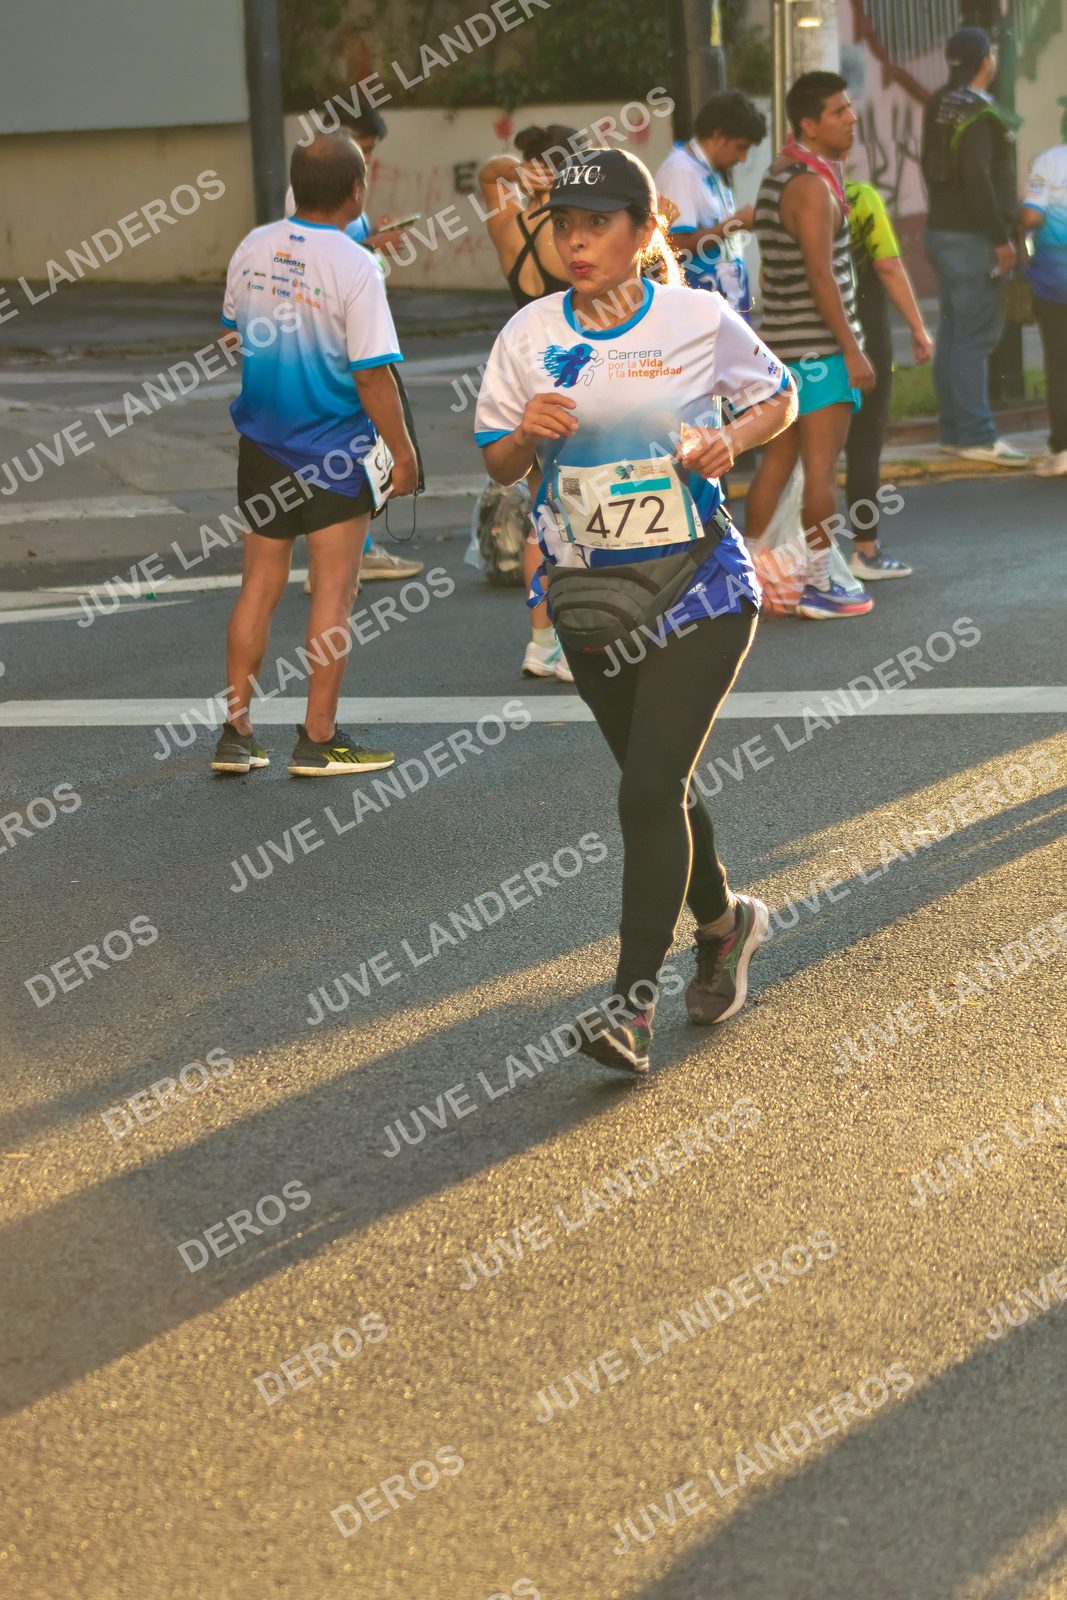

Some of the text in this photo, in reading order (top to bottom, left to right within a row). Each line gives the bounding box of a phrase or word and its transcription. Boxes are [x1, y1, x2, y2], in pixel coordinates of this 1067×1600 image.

[555, 165, 601, 190] NYC
[608, 349, 662, 360] Carrera
[608, 362, 624, 372] por
[639, 358, 663, 367] Vida
[608, 366, 682, 380] y la Integridad
[586, 495, 669, 539] 472
